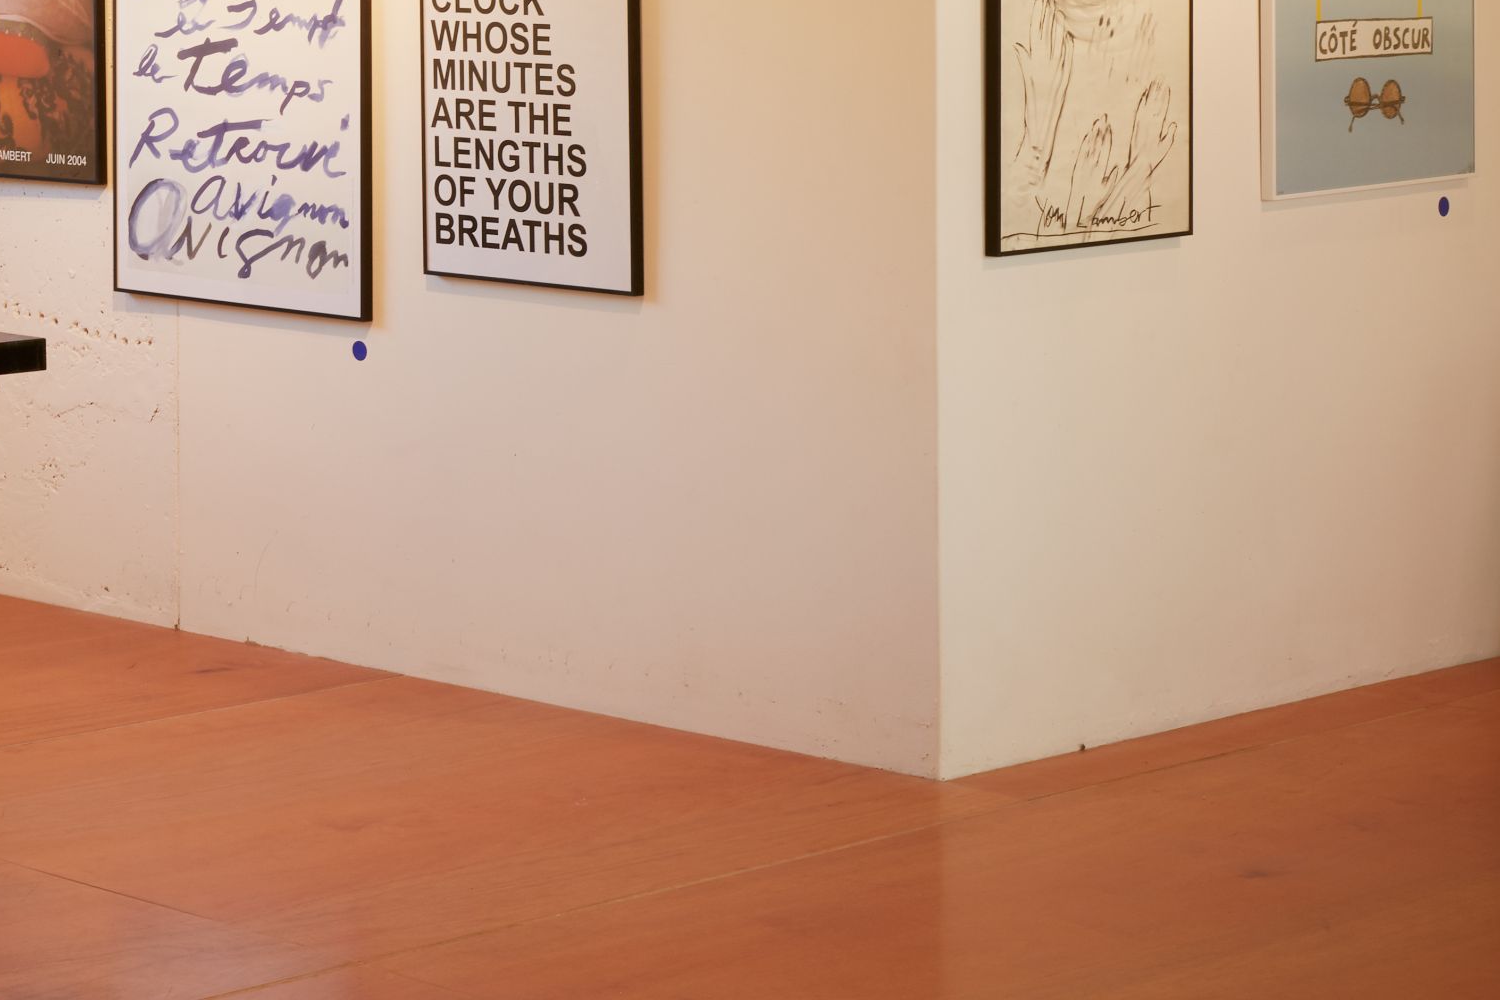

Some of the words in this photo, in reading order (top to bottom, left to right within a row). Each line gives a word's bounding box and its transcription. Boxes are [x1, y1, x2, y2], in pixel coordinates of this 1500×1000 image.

[431, 20, 552, 56] WHOSE
[1318, 20, 1358, 55] CÔTÉ
[1372, 26, 1430, 51] OBSCUR
[432, 59, 577, 97] MINUTES
[431, 97, 497, 131] ARE
[507, 101, 572, 137] THE
[45, 153, 65, 165] JUIN
[67, 155, 87, 166] 2004
[434, 136, 587, 178] LENGTHS
[434, 174, 476, 207] OF
[485, 177, 581, 218] YOUR
[435, 212, 588, 258] BREATHS
